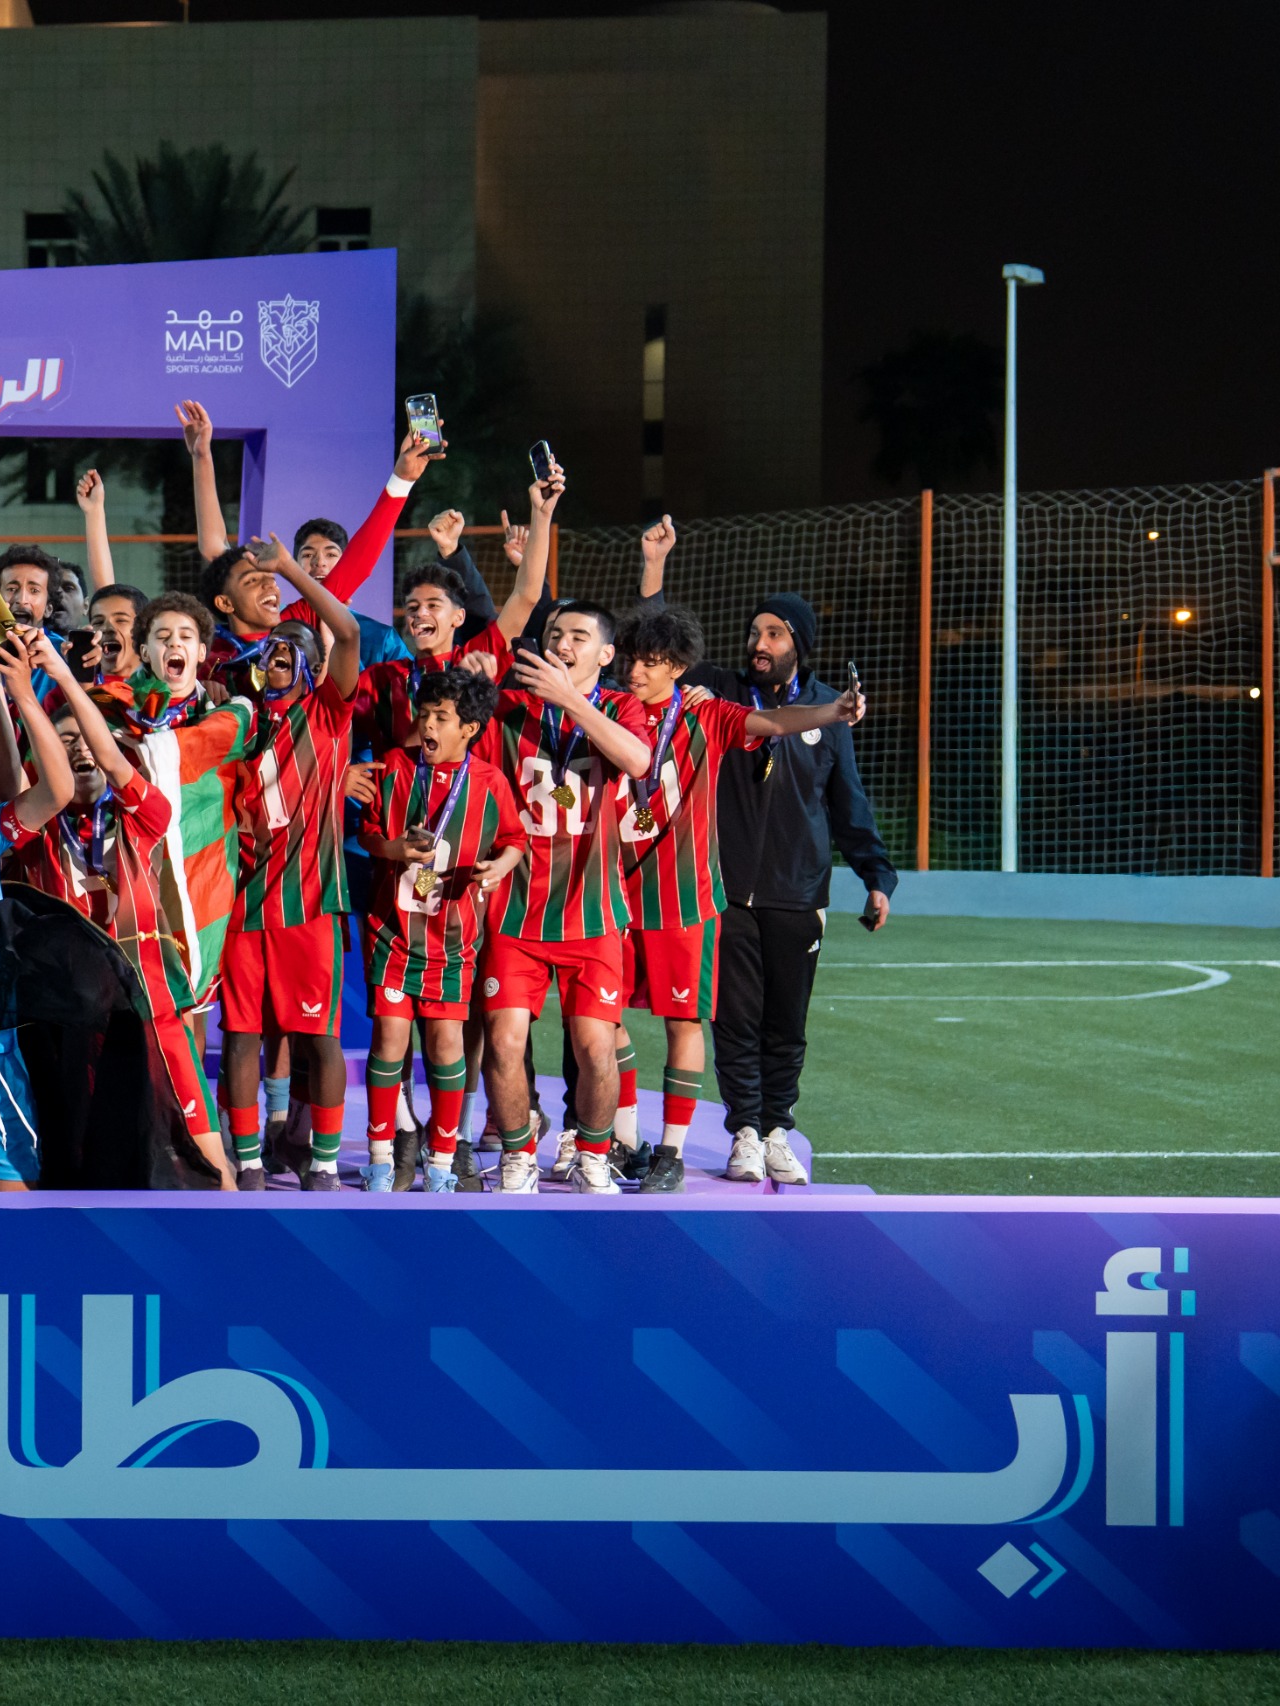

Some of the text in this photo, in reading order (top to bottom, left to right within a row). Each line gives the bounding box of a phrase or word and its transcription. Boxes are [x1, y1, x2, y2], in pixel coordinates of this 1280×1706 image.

[165, 309, 243, 330] مهد
[165, 330, 244, 351] MAHD
[165, 365, 244, 374] SPORTS ACADEMY
[519, 755, 603, 837] 30
